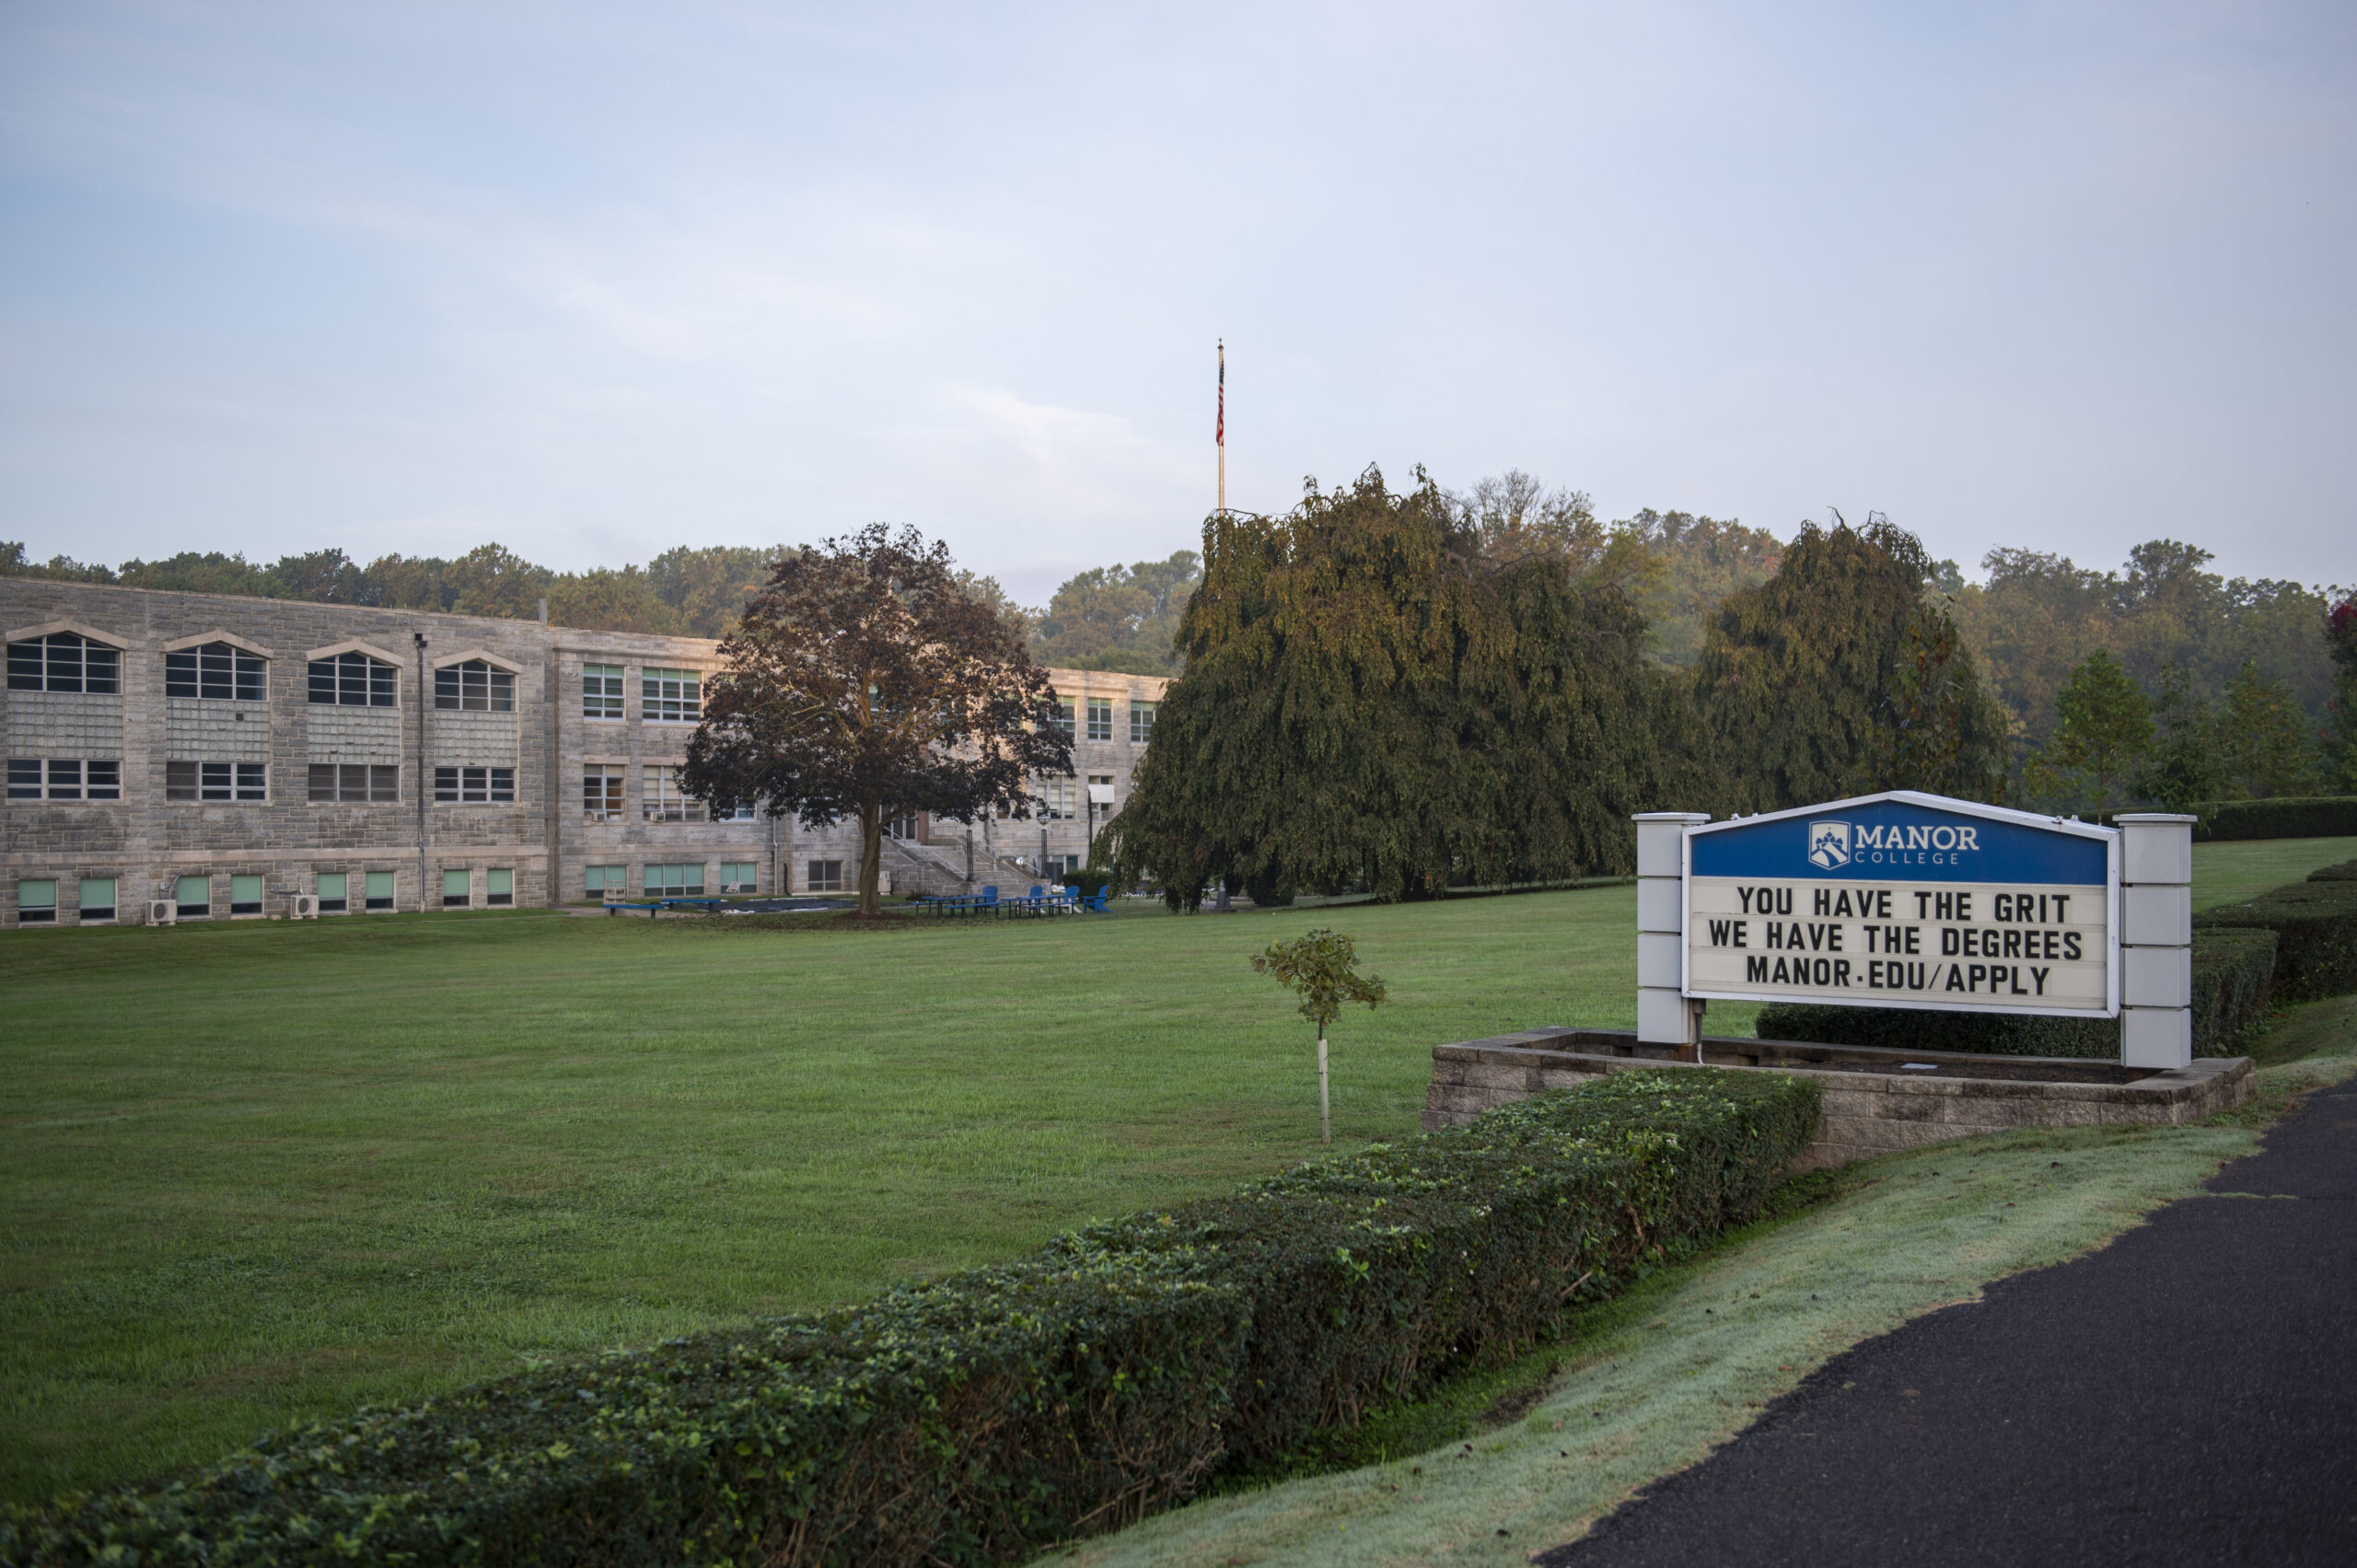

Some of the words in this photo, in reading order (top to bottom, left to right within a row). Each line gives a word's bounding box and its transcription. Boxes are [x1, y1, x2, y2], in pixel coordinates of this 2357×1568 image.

[1854, 825, 1980, 851] MANOR
[1854, 851, 1958, 865] COLLEGE
[1737, 887, 1793, 915] YOU
[1814, 889, 1892, 919] HAVE
[1914, 890, 1971, 921] THE
[1994, 893, 2071, 923] GRIT
[1709, 919, 1747, 948] WE
[1766, 921, 1842, 952] HAVE
[1864, 924, 1920, 955] THE
[1942, 927, 2082, 960] DEGREES
[1747, 955, 2050, 996] MANOR.EDU/APPLY
